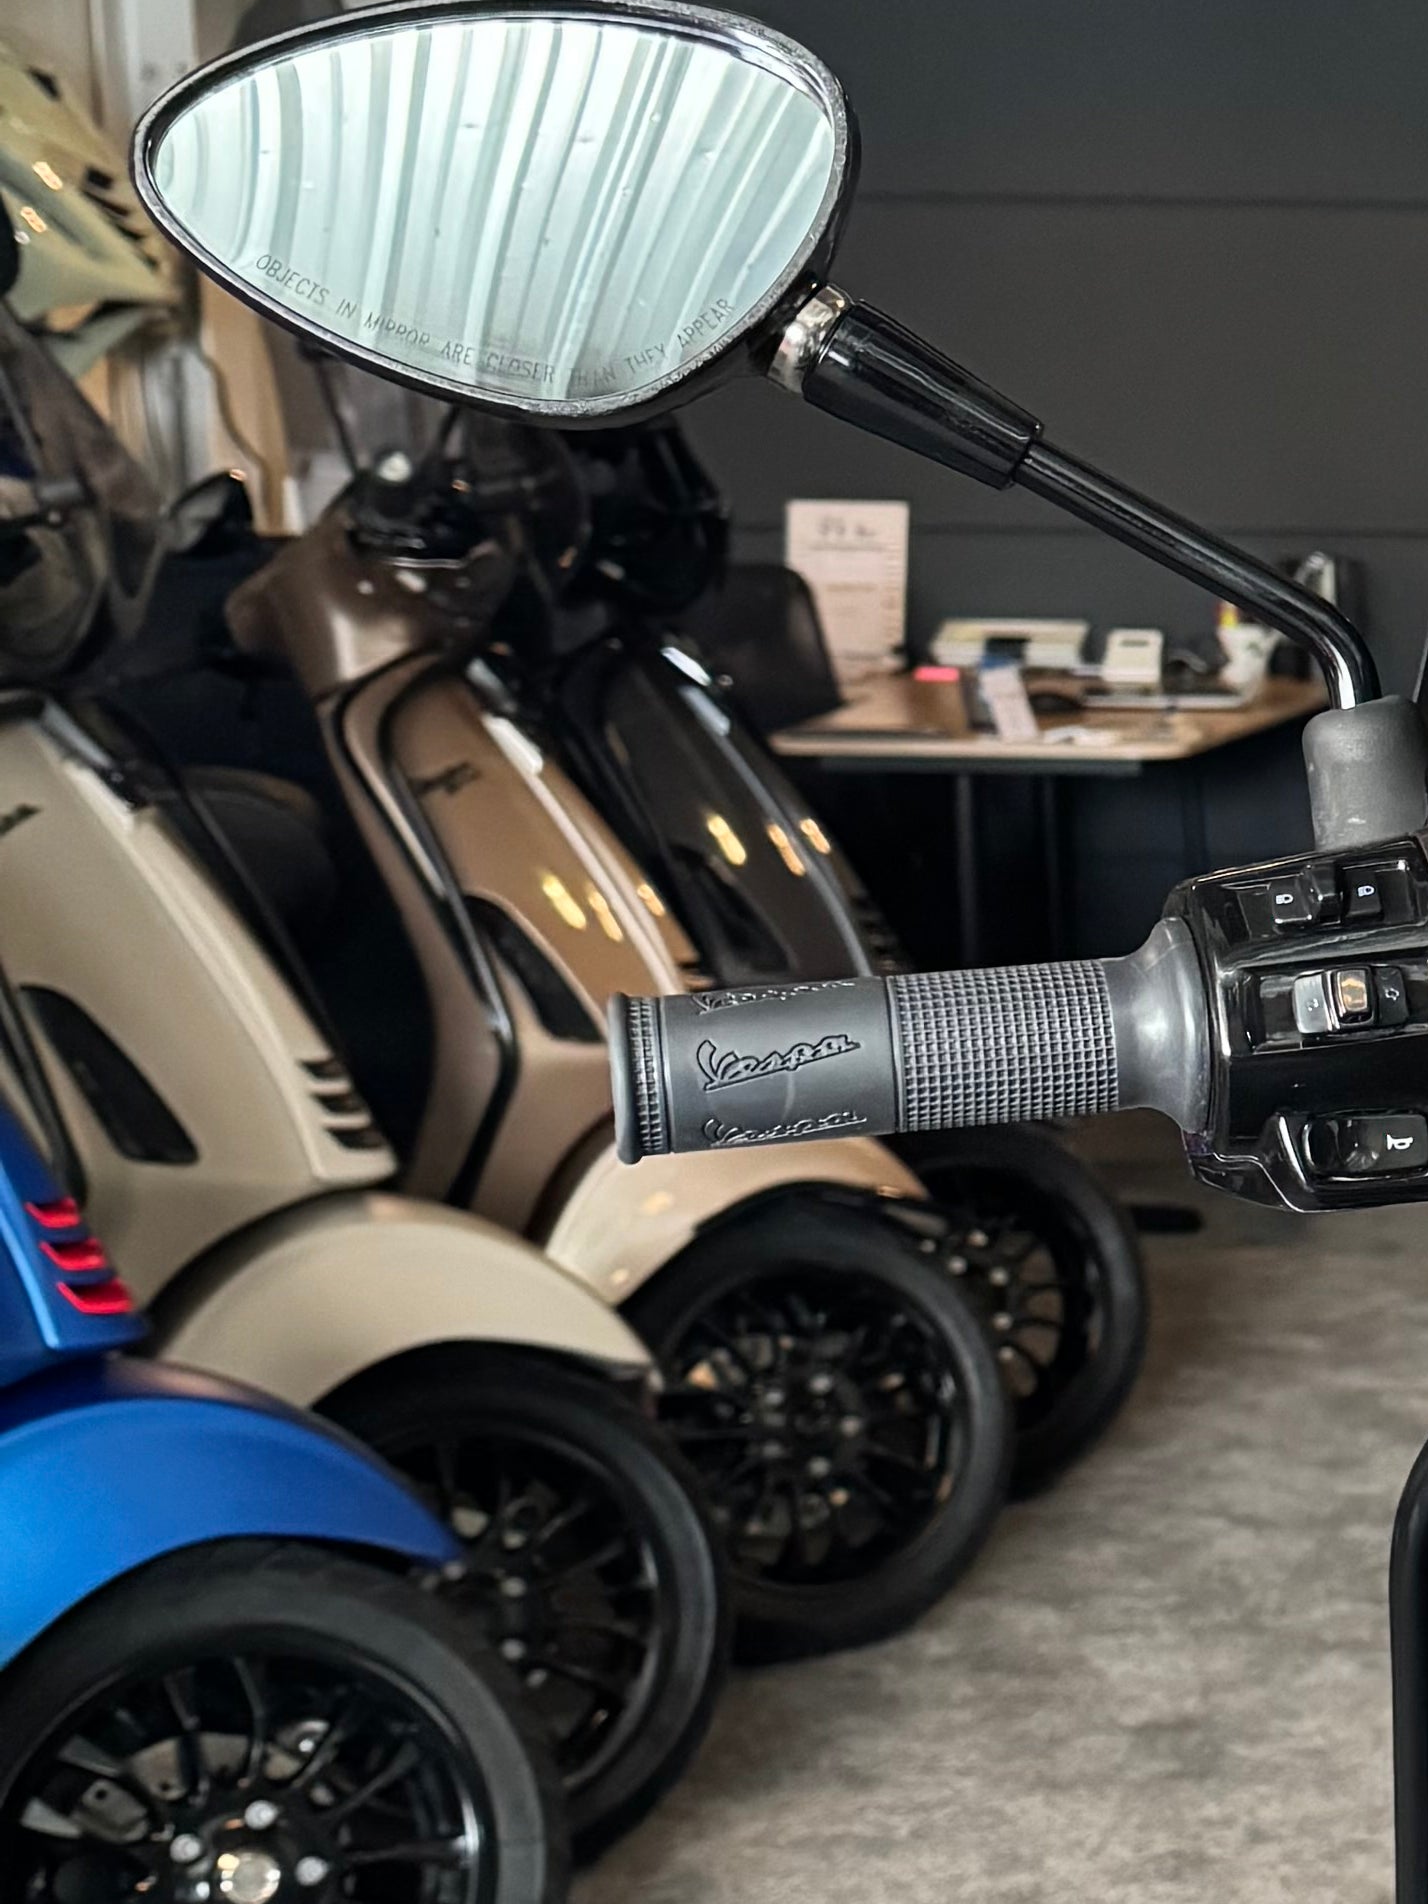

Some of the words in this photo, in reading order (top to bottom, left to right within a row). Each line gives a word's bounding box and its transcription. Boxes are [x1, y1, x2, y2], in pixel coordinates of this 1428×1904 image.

[256, 254, 330, 305] OBJECTS
[336, 299, 357, 319] IN
[441, 340, 472, 365] ARE
[677, 298, 735, 349] APPEAR
[696, 1034, 861, 1092] Vespa
